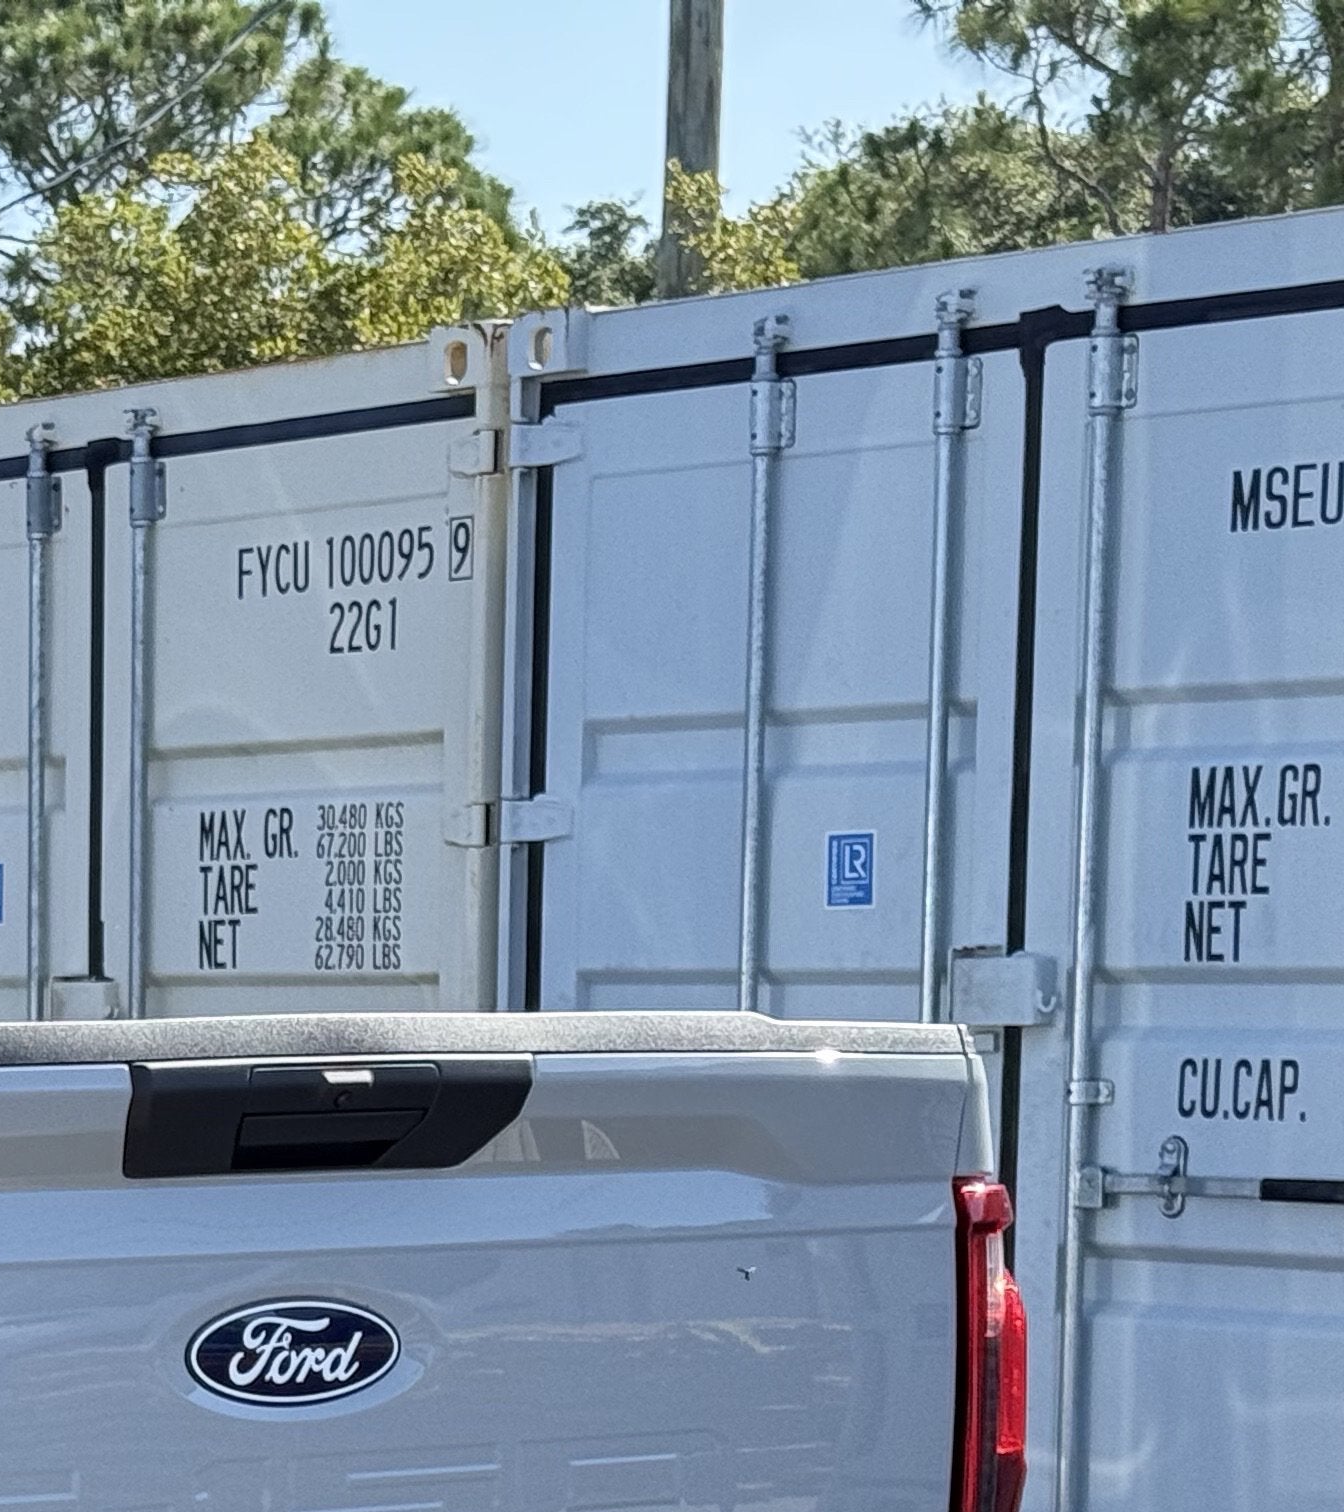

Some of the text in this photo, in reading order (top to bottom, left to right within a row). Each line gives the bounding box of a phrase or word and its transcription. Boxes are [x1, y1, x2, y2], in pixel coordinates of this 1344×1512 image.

[1230, 461, 1344, 533] MSEU
[237, 521, 471, 600] FYCU 100095 9
[329, 596, 398, 654] 22G1
[199, 802, 405, 862] MAX. GR. 30.480 KGS
[315, 830, 404, 859] 67.200 LBS
[199, 858, 403, 916] TARE 2.000 KGS
[1188, 832, 1272, 895] TARE
[324, 887, 402, 915] 4.410 LBS
[198, 919, 242, 971] NET
[372, 914, 402, 942] KGS
[314, 942, 402, 971] 62.790 LBS
[1183, 900, 1247, 963] NET
[1177, 1058, 1307, 1123] CU.CAP.
[228, 1316, 363, 1386] Ford
